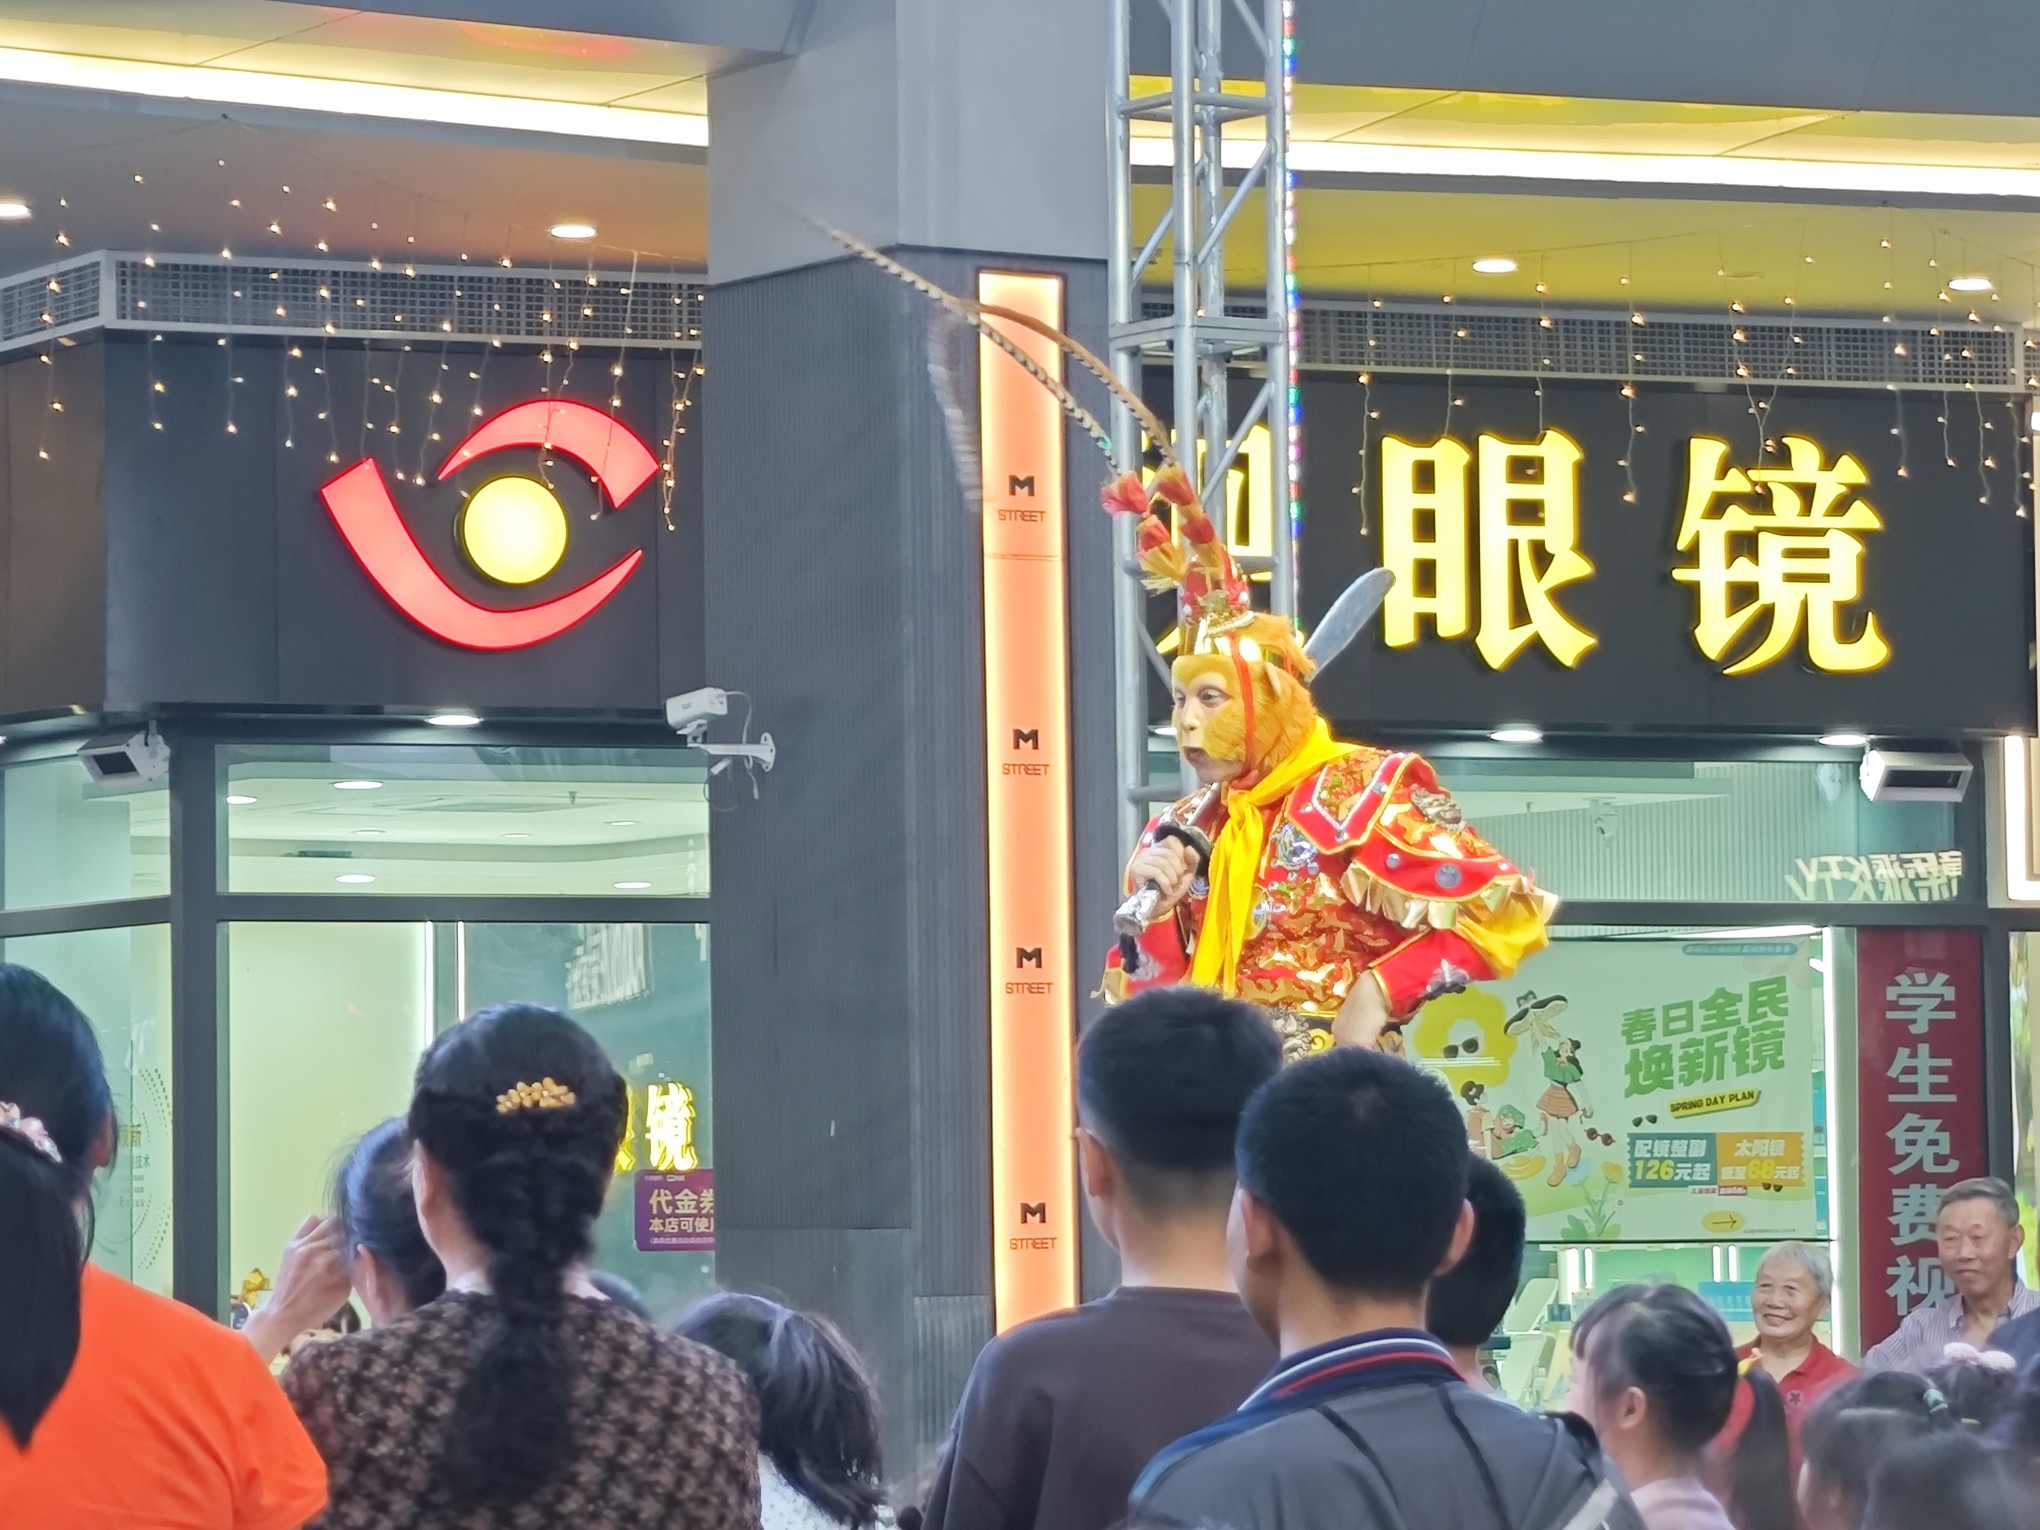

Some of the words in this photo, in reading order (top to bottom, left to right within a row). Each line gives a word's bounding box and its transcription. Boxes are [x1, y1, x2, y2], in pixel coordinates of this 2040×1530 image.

[1009, 475, 1035, 497] M
[998, 509, 1045, 522] STREET
[1013, 729, 1039, 750] M
[1002, 764, 1050, 776] STREET
[1016, 947, 1042, 968] M
[1005, 982, 1053, 994] STREET
[1621, 974, 1790, 1046] 春日全民
[1624, 1020, 1787, 1099] 焕新镜
[1670, 1101, 1704, 1113] SPRING
[1705, 1094, 1726, 1107] DAY
[1728, 1090, 1755, 1103] PLAN
[1635, 1159, 1711, 1181] 126元起
[1020, 1203, 1046, 1223] M
[1010, 1237, 1057, 1249] STREET
